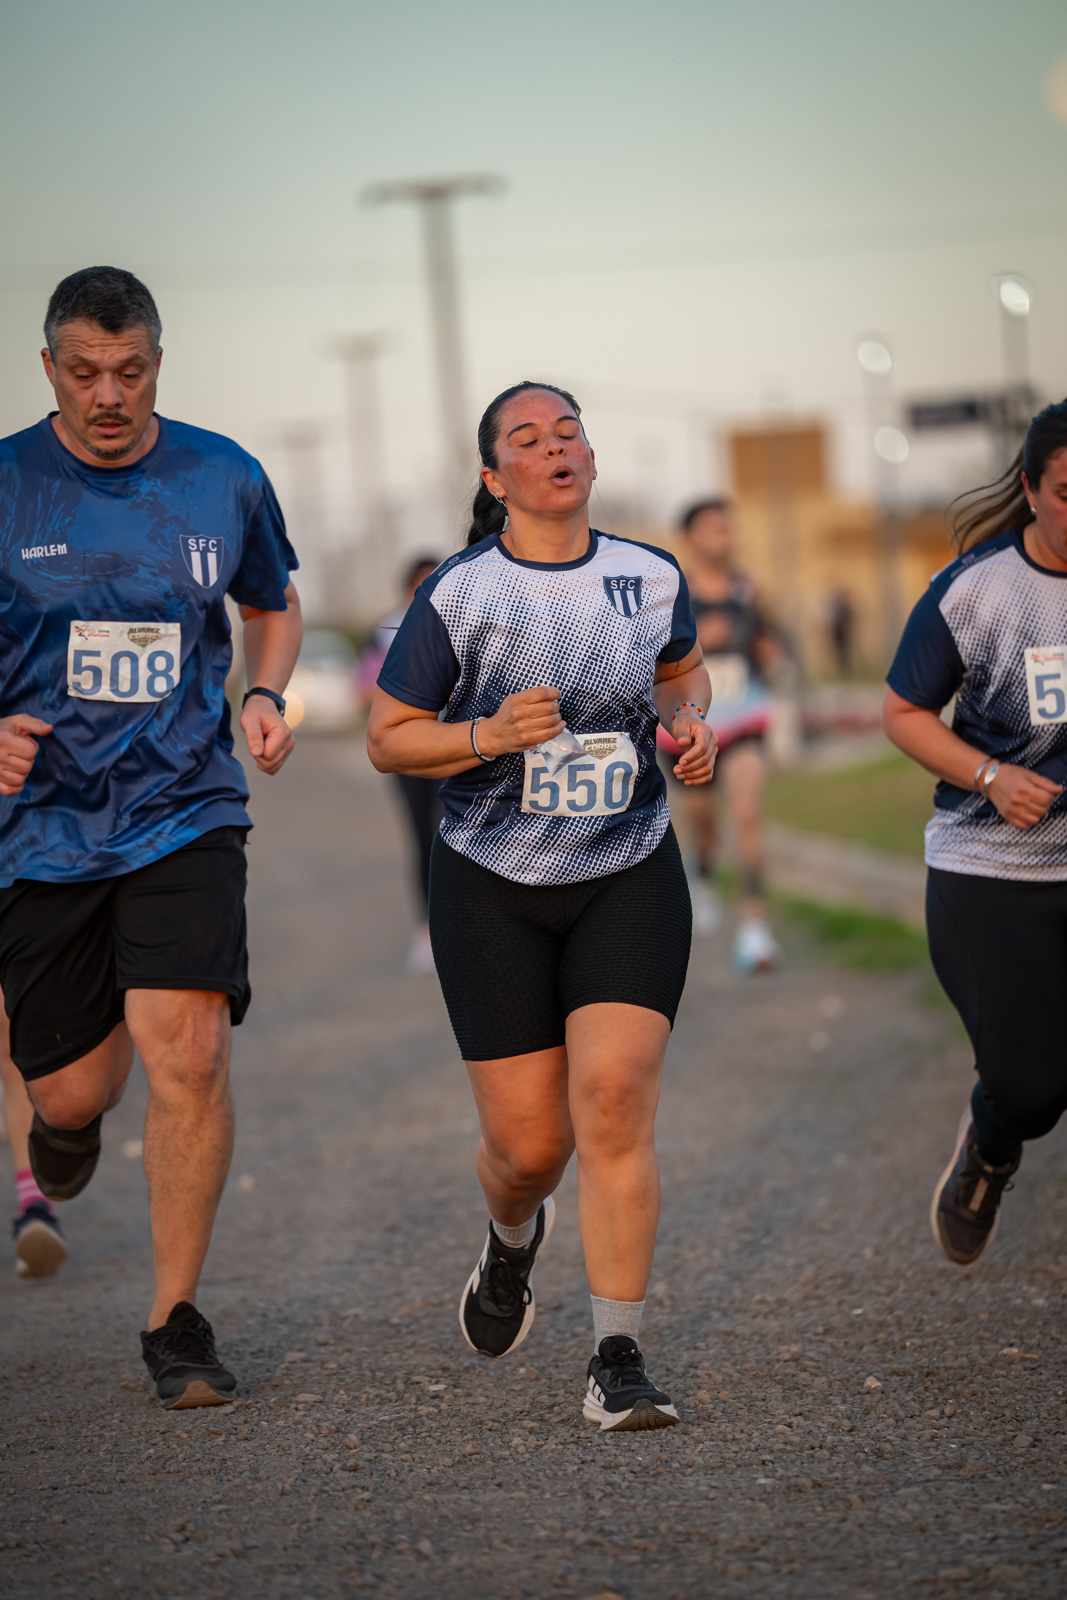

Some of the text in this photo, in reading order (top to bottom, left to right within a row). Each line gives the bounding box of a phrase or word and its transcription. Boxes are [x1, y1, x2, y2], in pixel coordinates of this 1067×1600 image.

[21, 543, 67, 560] HARLEM
[188, 538, 218, 551] SFC
[610, 579, 636, 590] SFC
[71, 649, 175, 698] 508
[1034, 673, 1066, 719] 5
[584, 737, 617, 745] ALVAREZ
[585, 743, 616, 752] CORRE
[528, 761, 633, 812] 550
